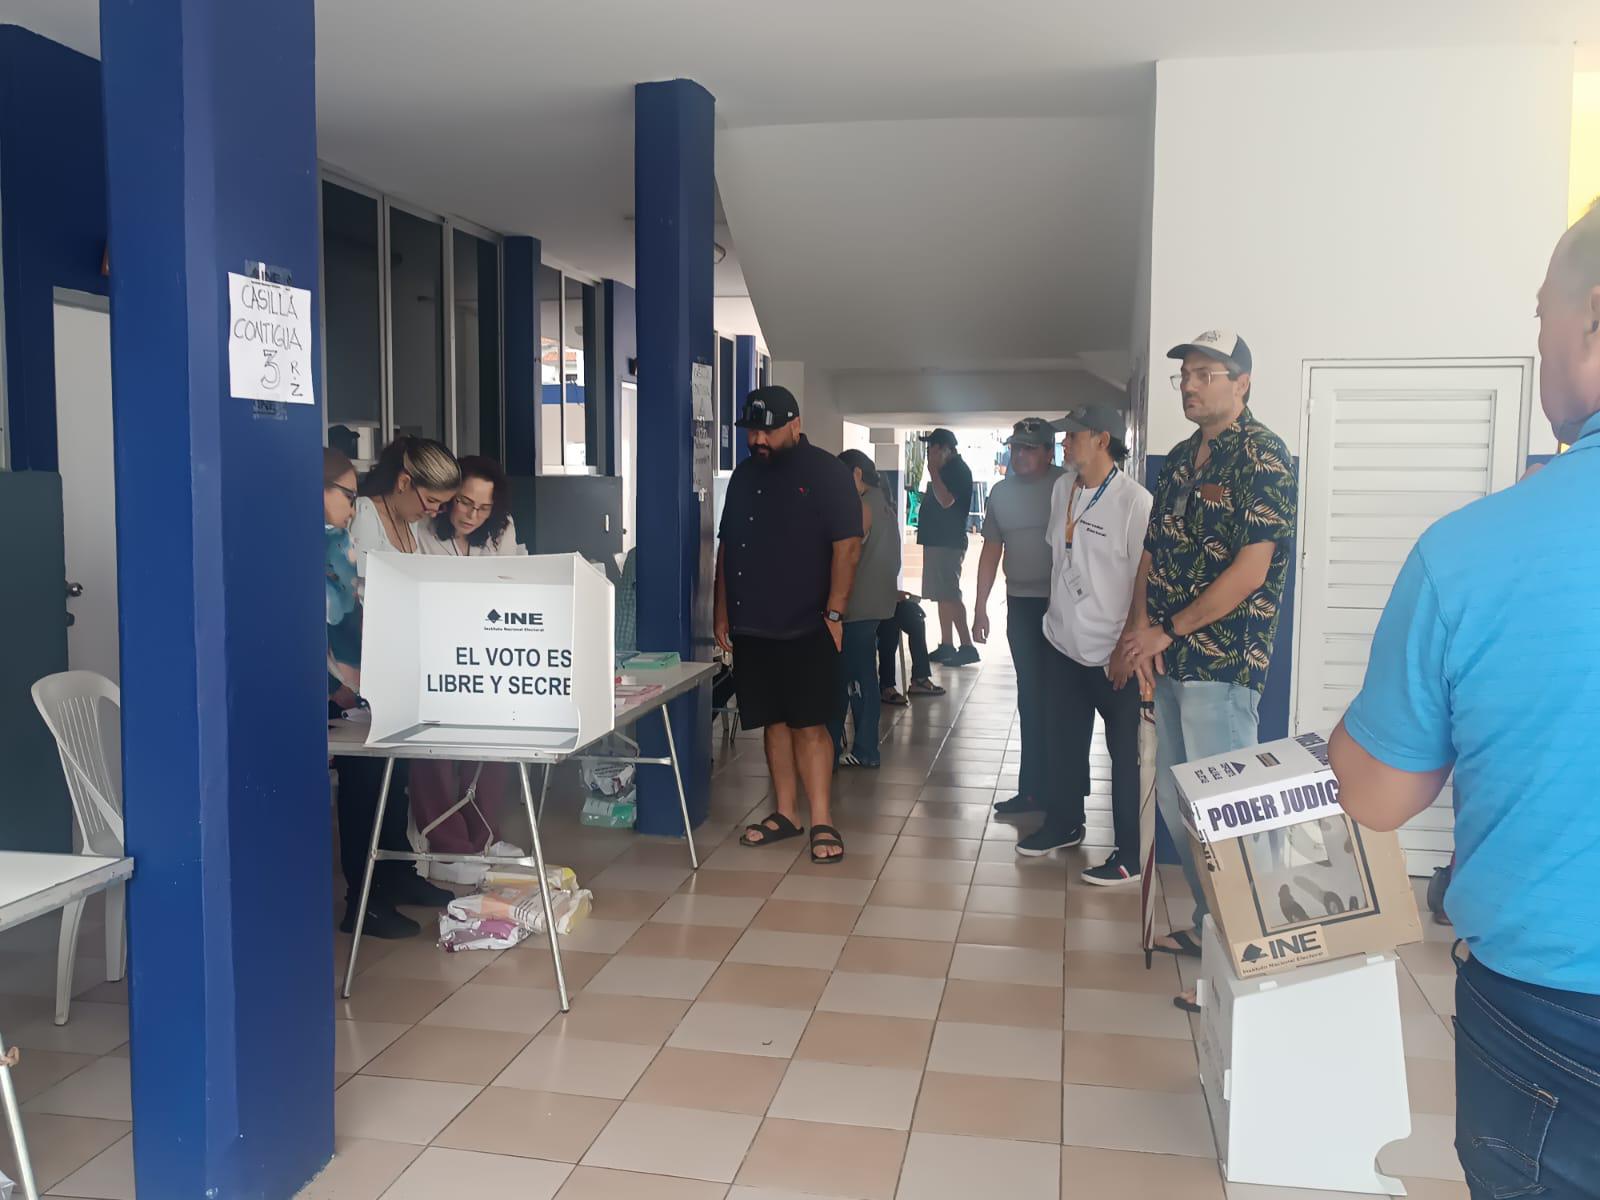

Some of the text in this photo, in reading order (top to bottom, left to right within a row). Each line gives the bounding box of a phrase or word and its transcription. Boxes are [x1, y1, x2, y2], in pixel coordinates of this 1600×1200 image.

[241, 284, 298, 319] CASILLA
[234, 318, 302, 350] CONTIGUA
[260, 349, 281, 390] 3
[504, 612, 544, 625] INE
[456, 646, 572, 668] EL VOTO ES
[427, 674, 571, 696] LIBRE Y SECRE
[1207, 794, 1279, 831] PODER
[1280, 779, 1339, 816] JUDIC
[1268, 930, 1322, 959] INE
